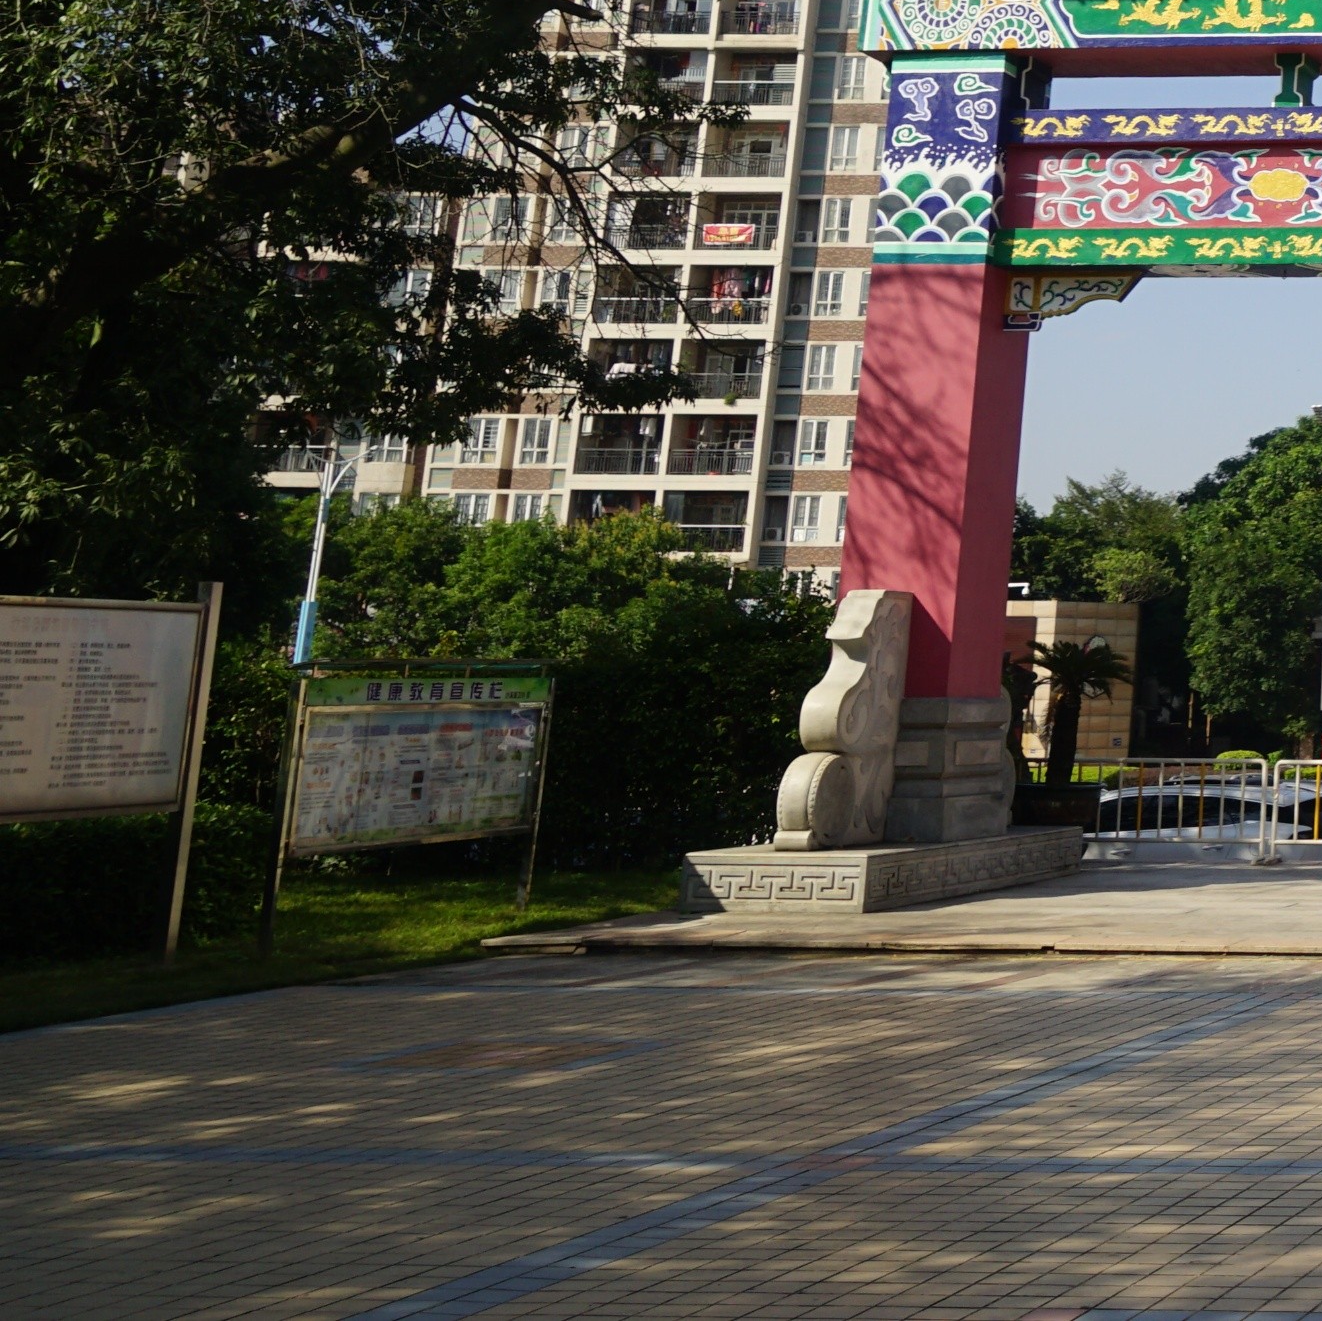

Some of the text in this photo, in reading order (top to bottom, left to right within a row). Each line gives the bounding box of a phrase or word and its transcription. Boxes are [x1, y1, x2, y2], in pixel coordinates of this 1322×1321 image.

[366, 681, 503, 701] 健康教育宣传栏
